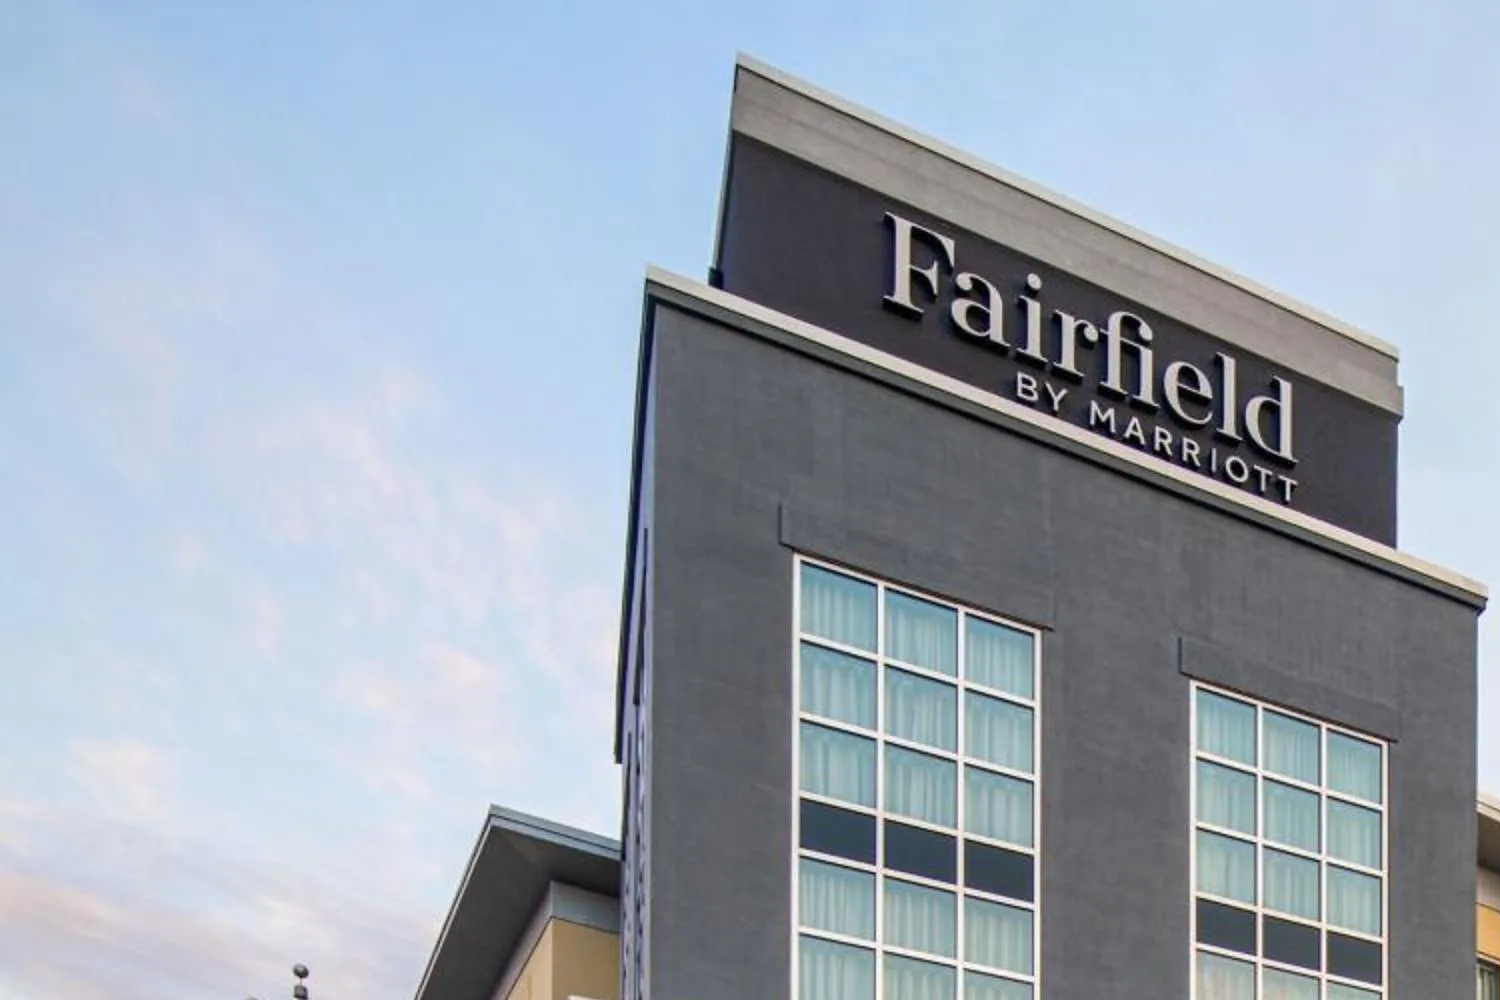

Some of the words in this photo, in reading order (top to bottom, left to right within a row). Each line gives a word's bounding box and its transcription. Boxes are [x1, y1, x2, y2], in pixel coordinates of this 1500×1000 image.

[884, 212, 1299, 464] Fairfield
[1016, 371, 1067, 411] BY
[1090, 400, 1298, 502] MARRIOTT
